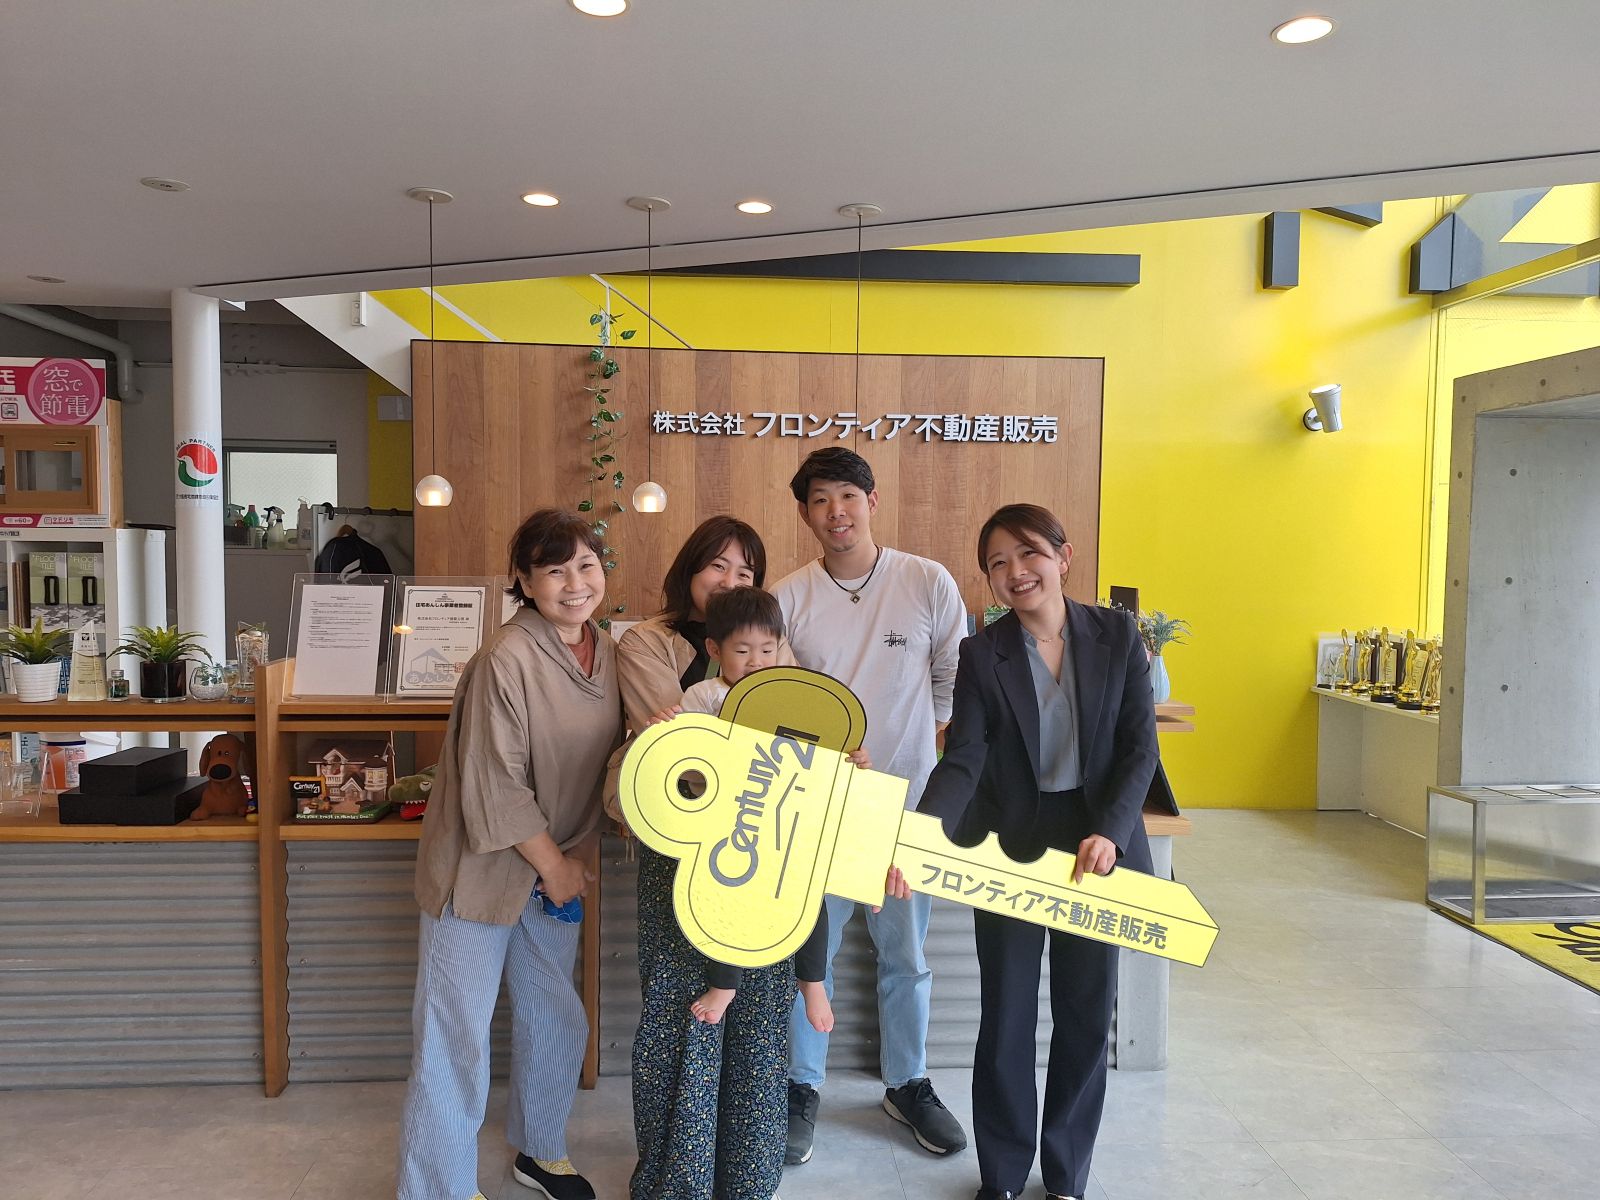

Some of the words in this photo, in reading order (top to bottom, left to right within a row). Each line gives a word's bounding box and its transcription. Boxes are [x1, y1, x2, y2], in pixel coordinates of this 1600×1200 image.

[42, 366, 84, 392] 窓で
[39, 393, 90, 418] 節電
[652, 410, 746, 436] 株式会社
[751, 411, 1059, 443] フロンティア不動産販売
[708, 742, 780, 887] Century
[769, 725, 821, 770] 21
[920, 863, 1169, 950] フロンティア不動産販売
